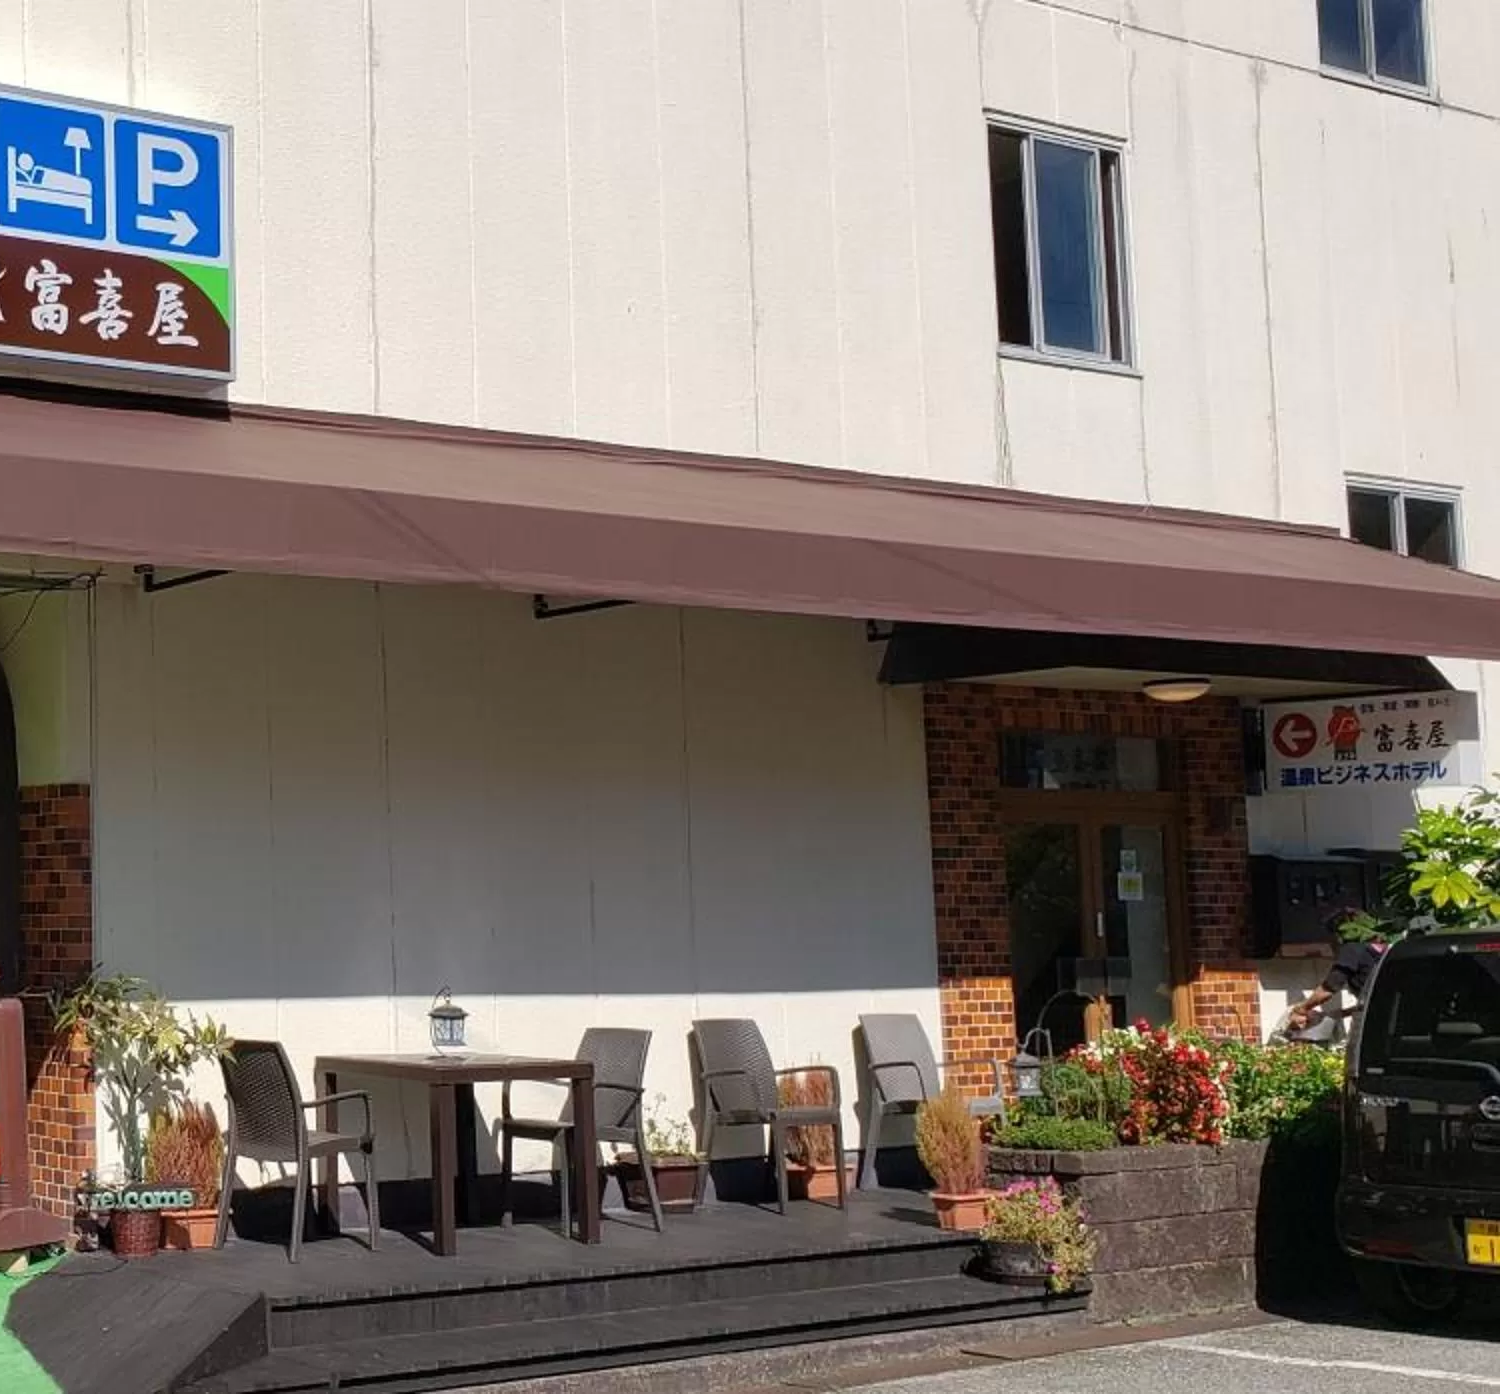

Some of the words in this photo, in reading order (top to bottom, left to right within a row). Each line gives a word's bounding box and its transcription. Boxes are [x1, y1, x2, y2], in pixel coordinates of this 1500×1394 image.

[24, 259, 199, 348] 富喜屋
[1373, 719, 1451, 753] 富喜屋
[1280, 761, 1447, 787] 温泉ビジネスホテル
[78, 1189, 195, 1209] welcome
